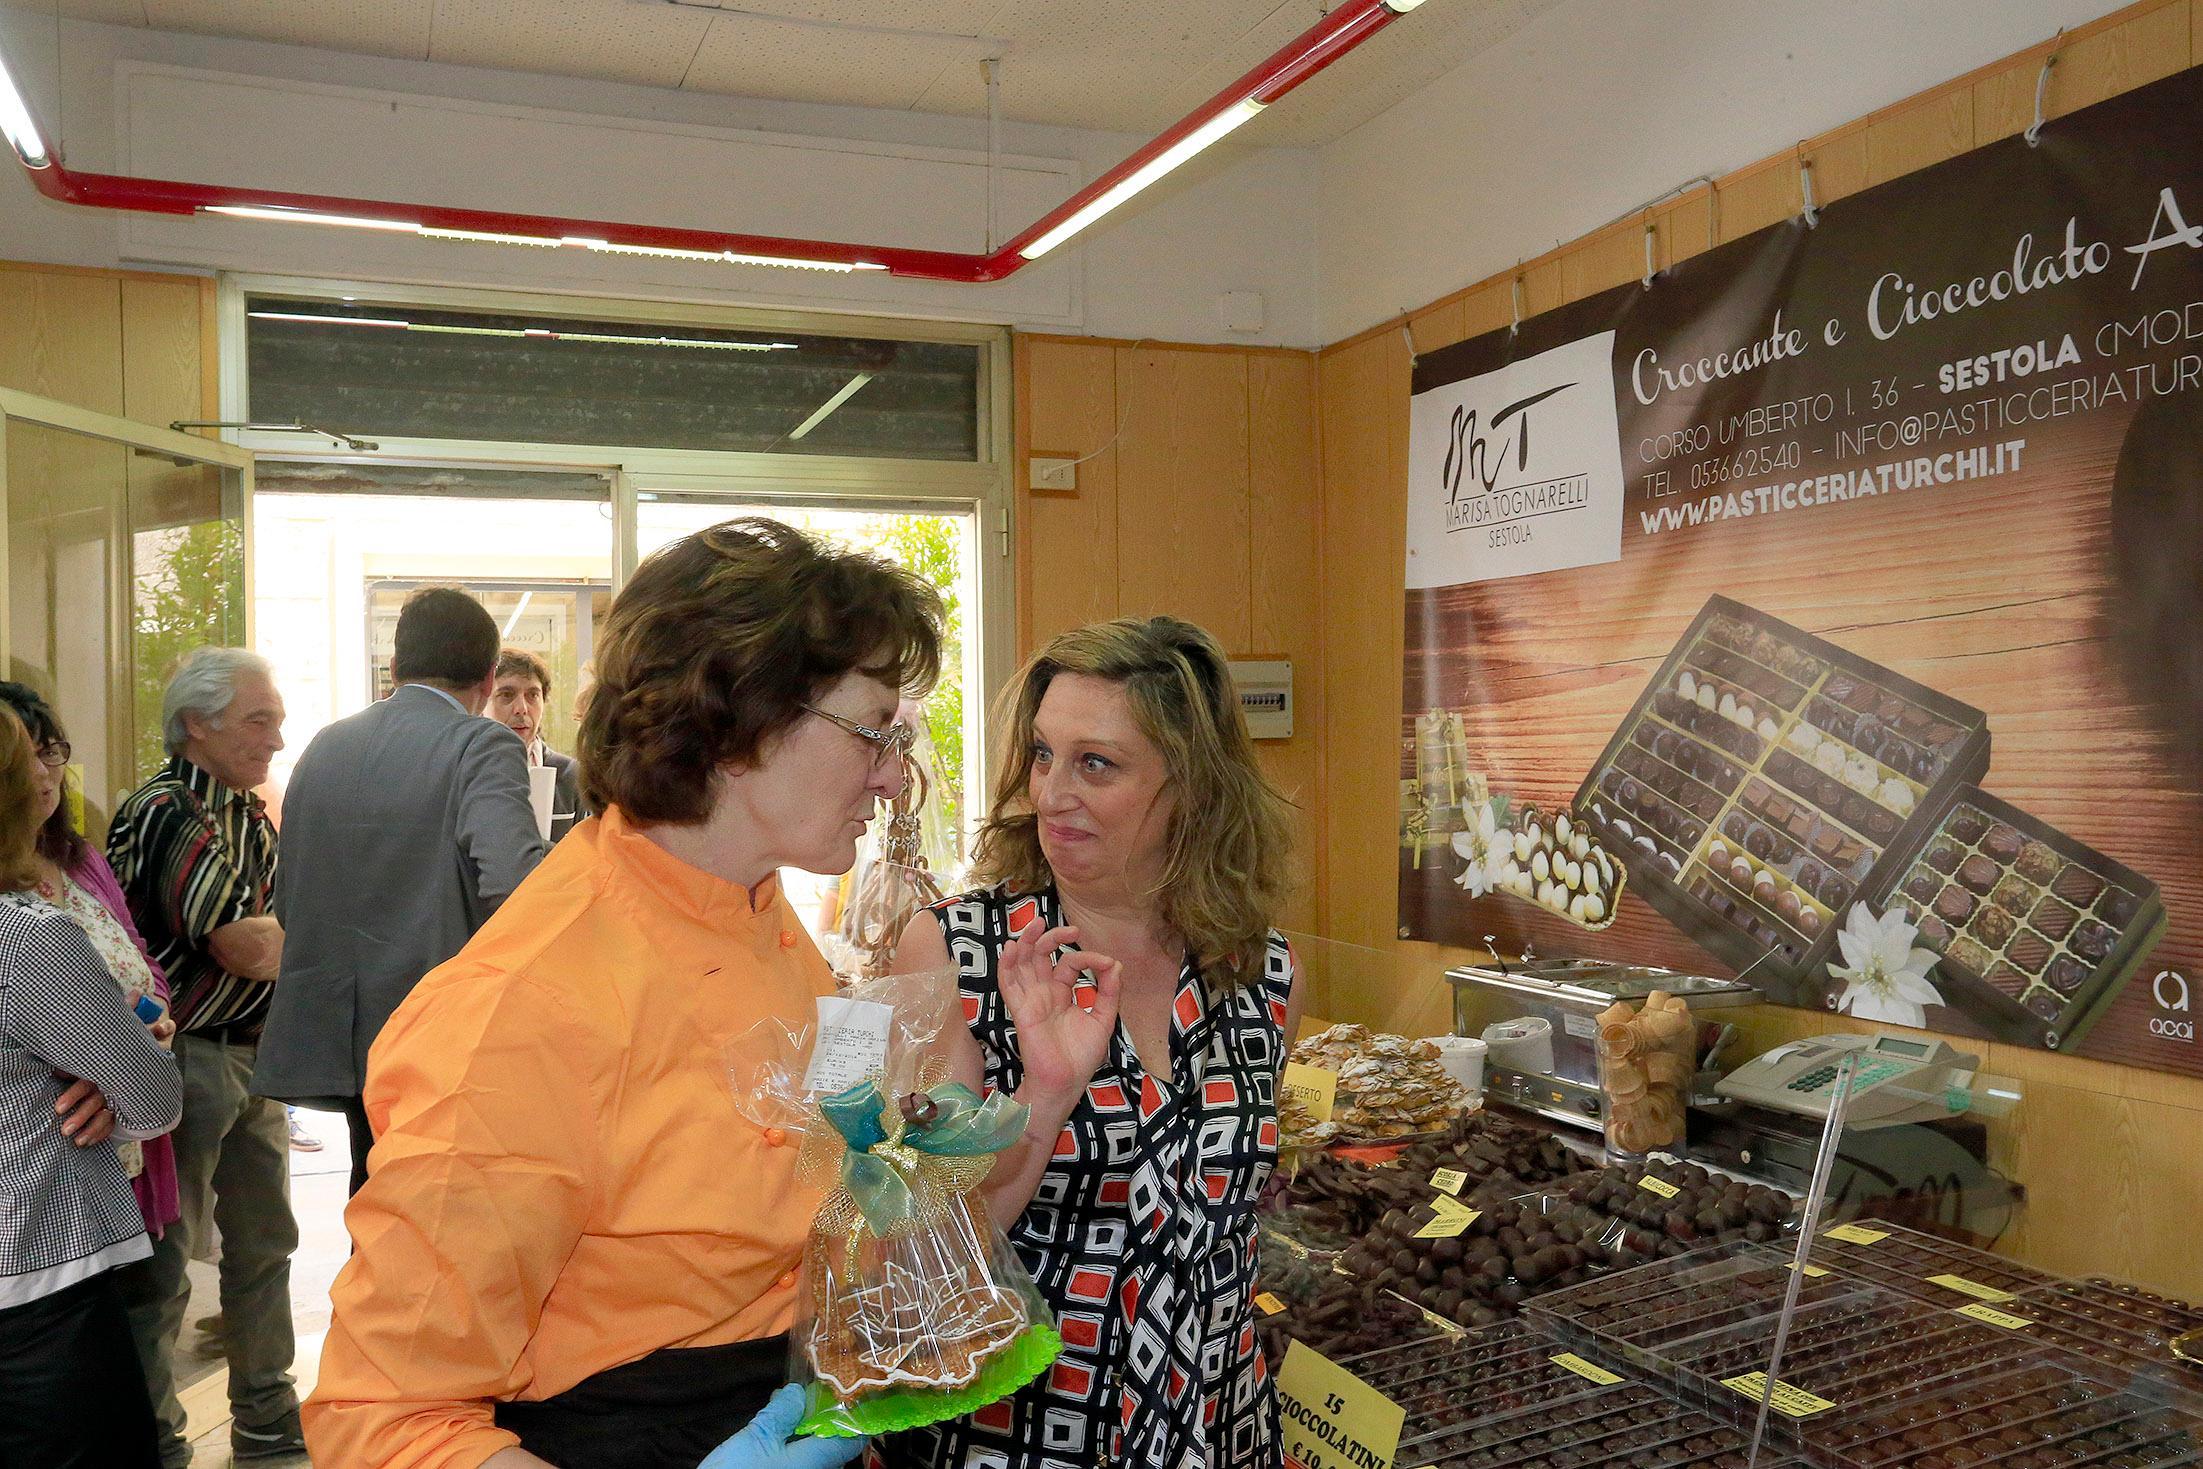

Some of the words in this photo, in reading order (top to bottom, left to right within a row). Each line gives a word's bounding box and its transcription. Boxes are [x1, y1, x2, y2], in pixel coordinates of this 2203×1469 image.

[1632, 308, 1808, 405] Croccante
[1824, 319, 1846, 346] e
[1868, 216, 2110, 340] Cioccolato
[1640, 425, 1710, 463] CORSO
[1719, 393, 1834, 445] UMBERTO
[1871, 376, 1899, 411] 36
[1939, 333, 2082, 394] SESTOLA
[1643, 470, 1682, 499] TEL.
[1836, 354, 2203, 461] INFO@PASTICCERIATUR
[1445, 500, 1492, 529] MARISA
[1493, 478, 1589, 520] TOGNARELLI
[1640, 439, 2027, 535] WWW.PASTICCERIATURCHI.IT
[1488, 524, 1534, 549] SESTOLA
[1323, 1392, 1346, 1416] 15
